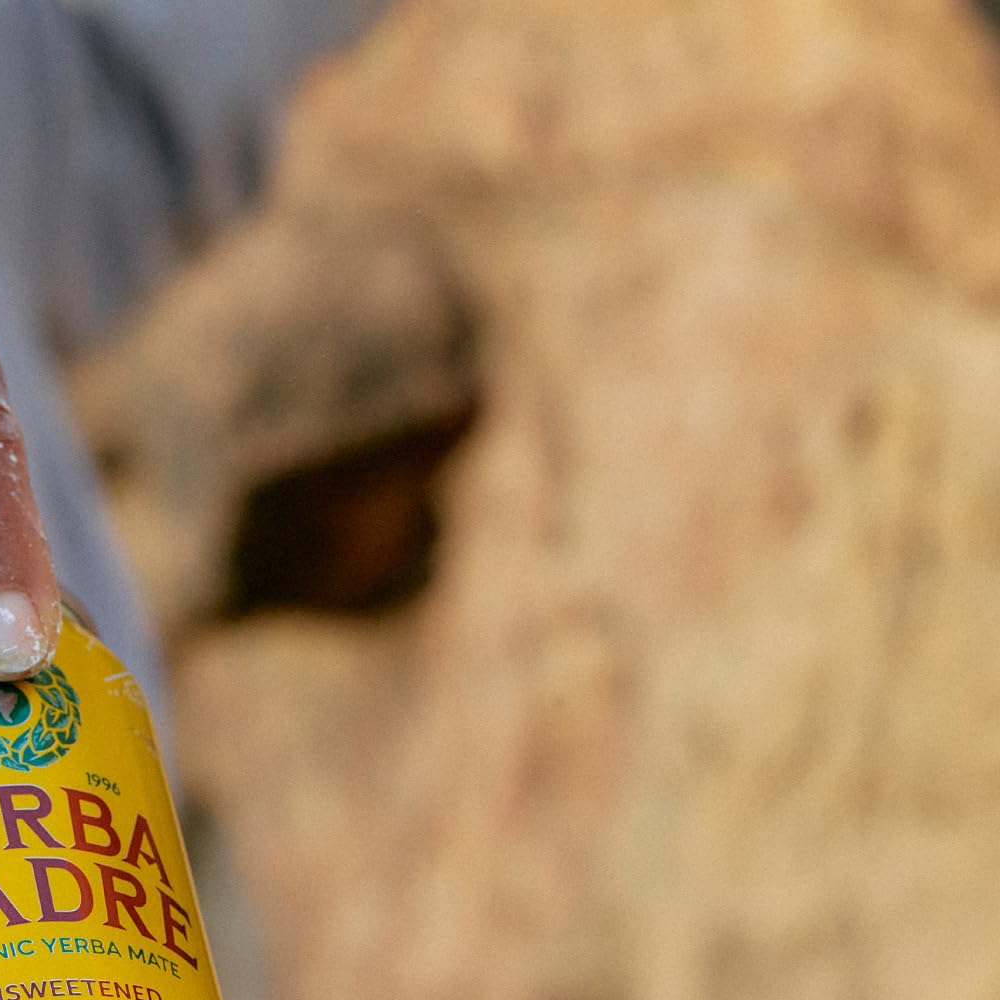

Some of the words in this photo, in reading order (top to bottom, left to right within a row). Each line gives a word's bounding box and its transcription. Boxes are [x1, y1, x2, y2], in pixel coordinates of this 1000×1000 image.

[86, 771, 121, 796] 1996
[41, 937, 122, 958] YERBA
[127, 945, 182, 979] MATE
